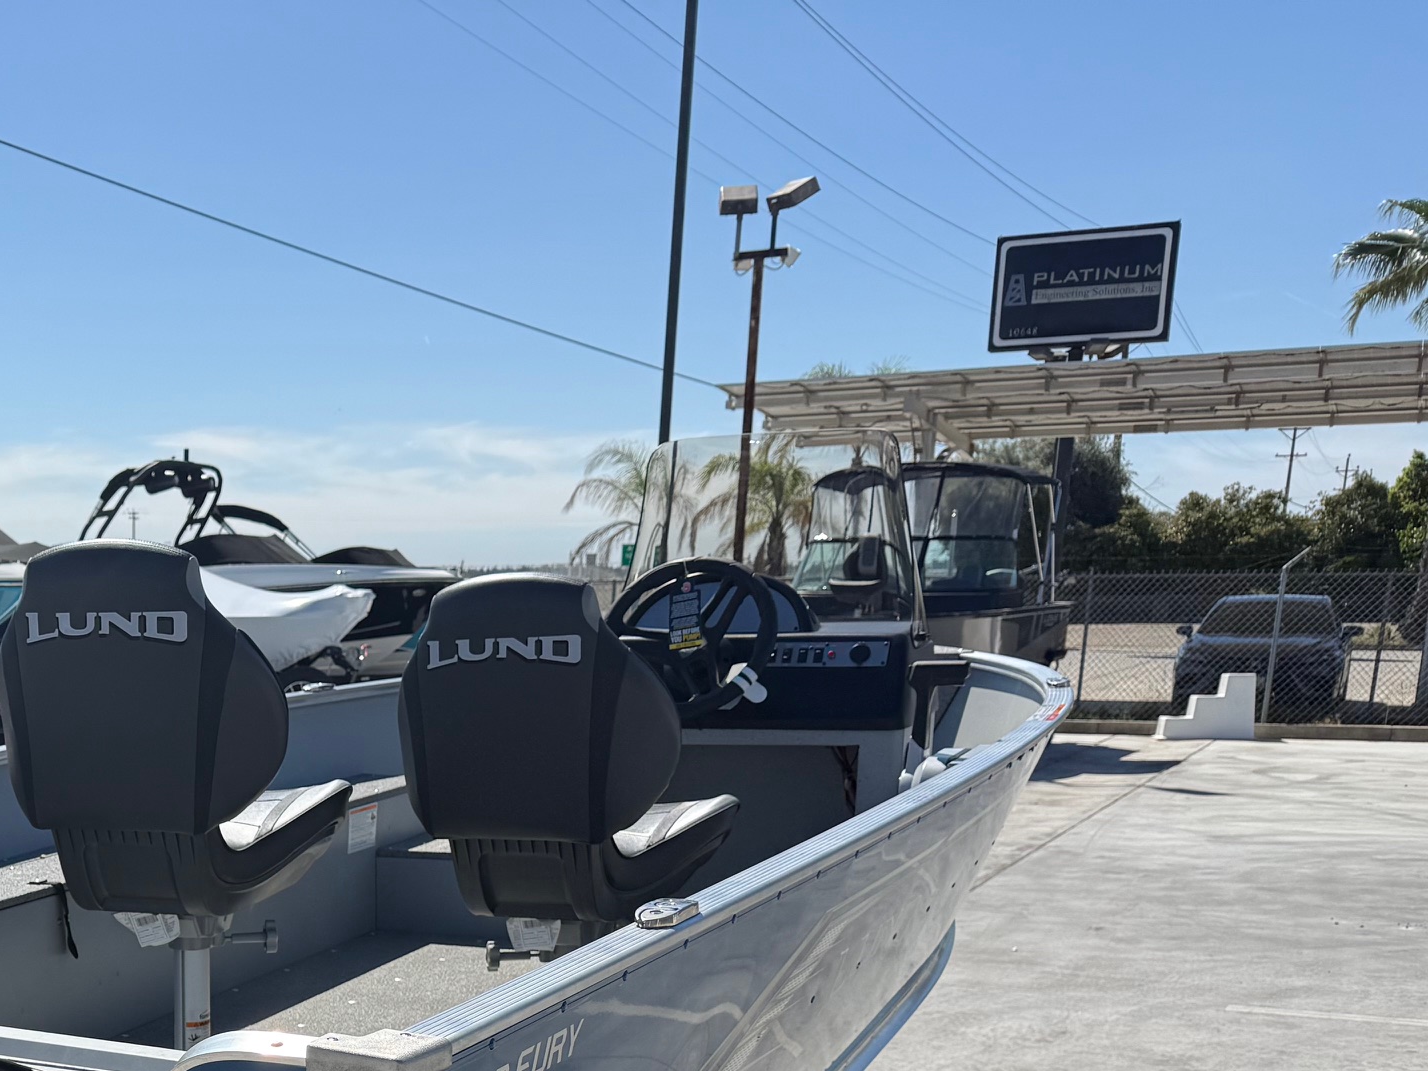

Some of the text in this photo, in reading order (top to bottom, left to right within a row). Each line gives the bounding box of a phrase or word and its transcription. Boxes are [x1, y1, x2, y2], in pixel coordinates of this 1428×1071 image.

[1033, 263, 1162, 286] PLATINUM
[1034, 289, 1090, 301] Engineering
[25, 610, 188, 644] LUND
[427, 634, 581, 670] LUND
